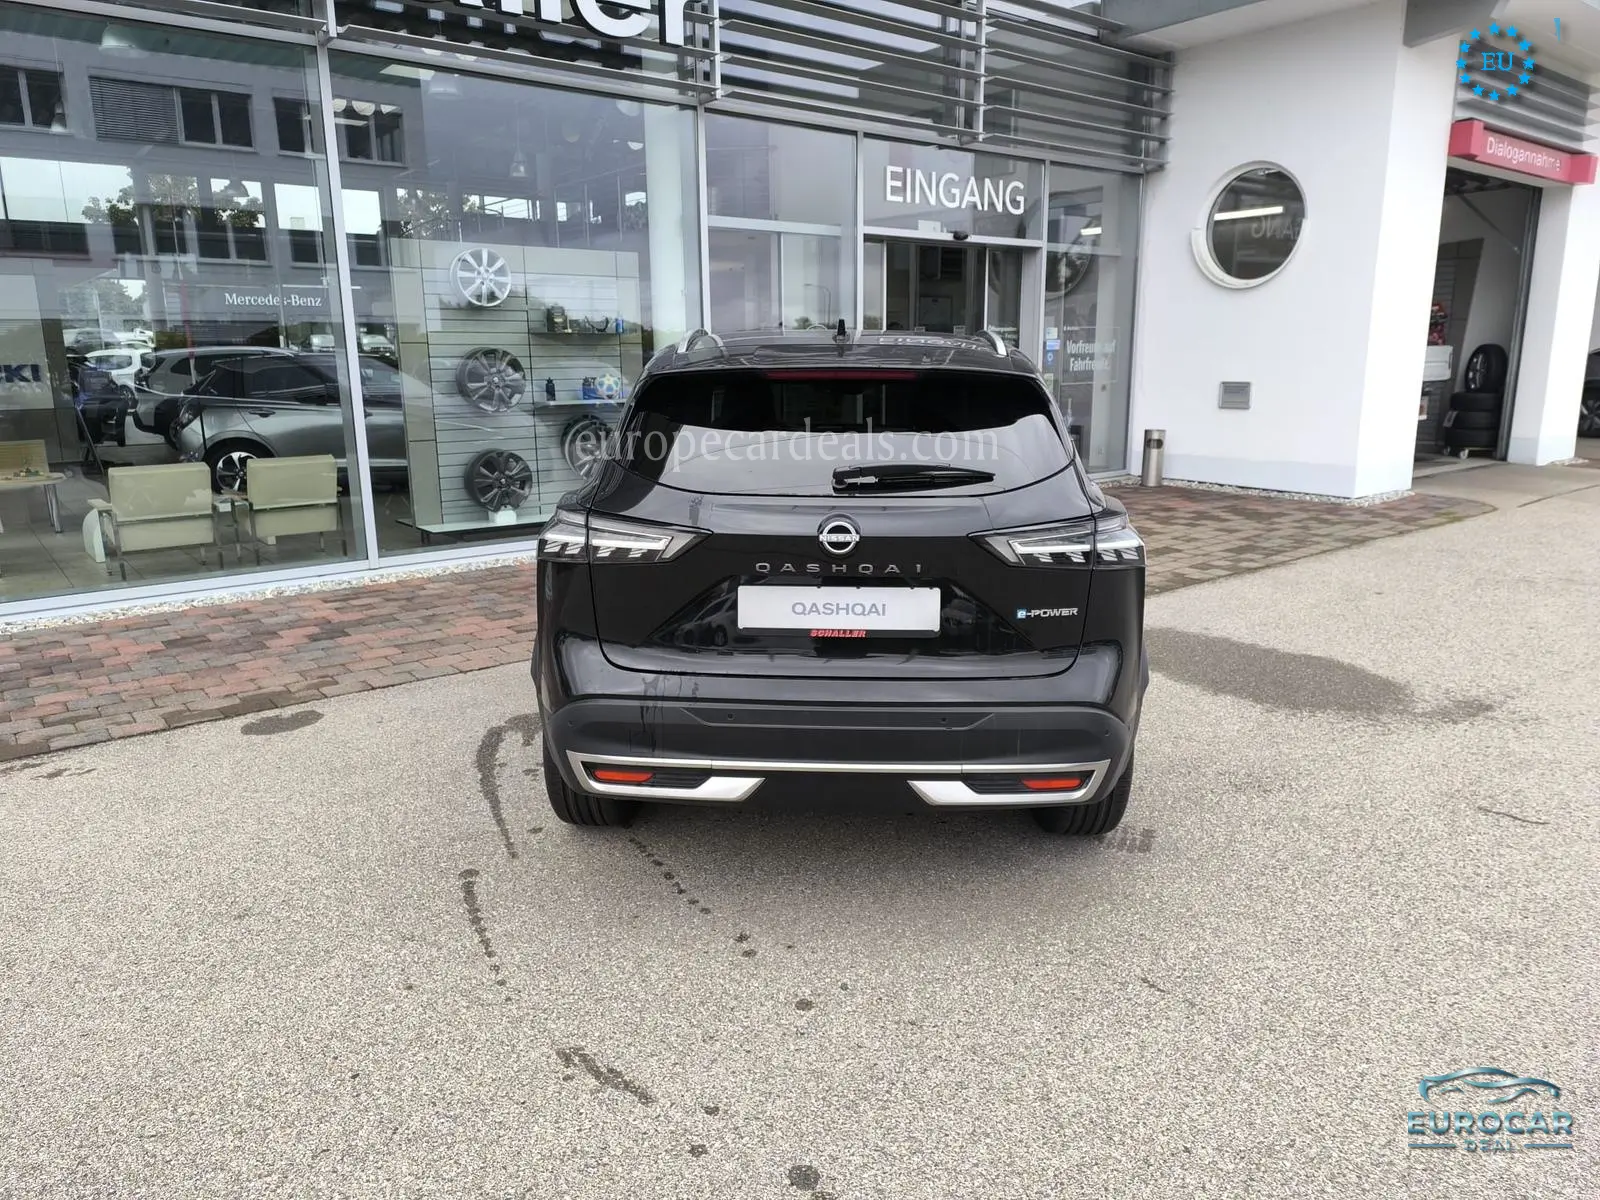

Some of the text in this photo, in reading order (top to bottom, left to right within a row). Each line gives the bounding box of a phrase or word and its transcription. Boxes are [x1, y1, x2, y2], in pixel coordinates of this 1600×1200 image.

[886, 165, 1025, 215] EINGANG
[224, 293, 322, 307] Mercedes-Benz
[819, 534, 860, 543] NISSAN
[755, 562, 922, 574] QASHQAI
[1017, 607, 1078, 619] e-POWER
[810, 629, 867, 638] SCHALLER
